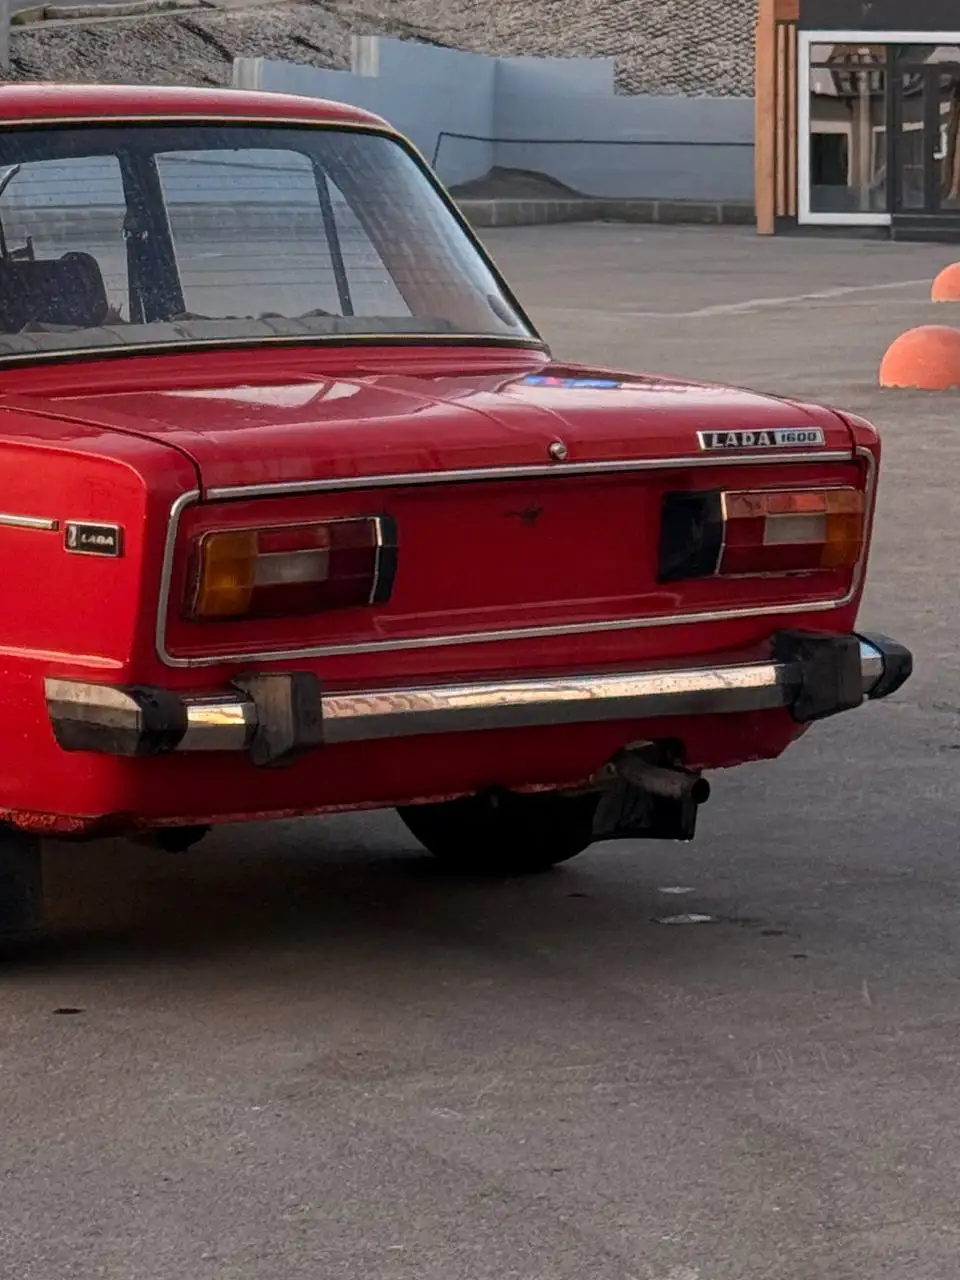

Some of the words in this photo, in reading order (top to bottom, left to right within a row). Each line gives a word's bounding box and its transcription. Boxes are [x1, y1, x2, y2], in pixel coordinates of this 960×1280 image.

[711, 431, 770, 448] LADA
[780, 431, 817, 443] 1600
[81, 533, 114, 546] LADA
